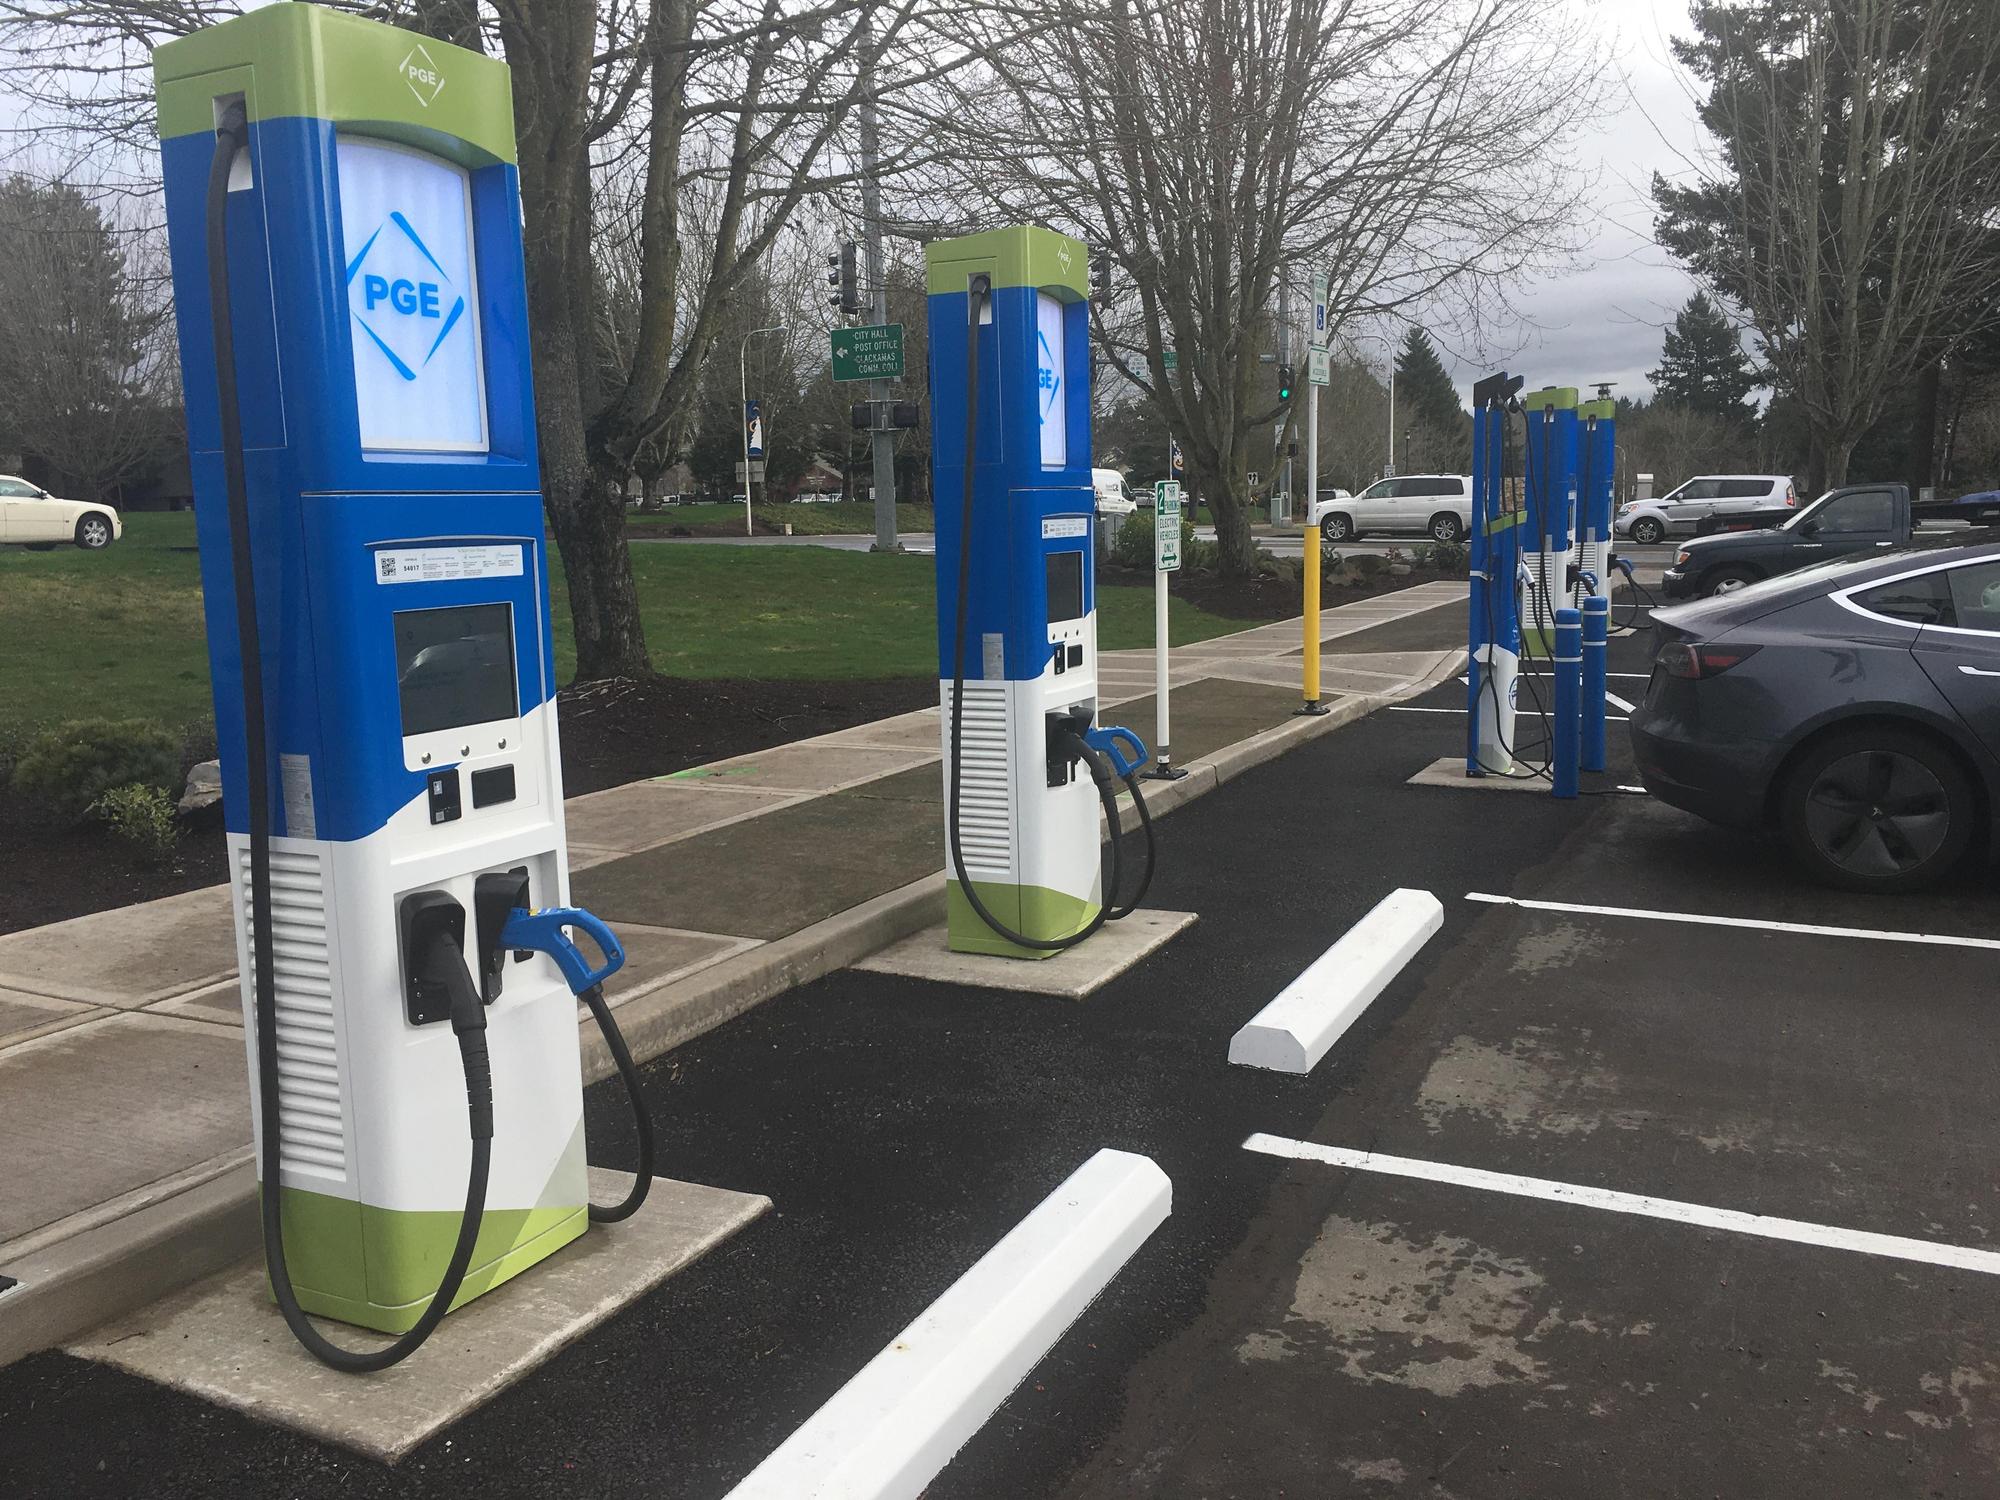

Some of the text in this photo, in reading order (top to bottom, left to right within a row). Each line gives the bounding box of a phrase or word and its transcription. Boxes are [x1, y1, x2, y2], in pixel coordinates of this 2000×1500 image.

[408, 65, 437, 86] PGE
[1060, 252, 1070, 263] PGE
[364, 274, 441, 319] PGE
[854, 329, 888, 340] CITY HALL
[855, 340, 898, 352] POST OFFICE
[1038, 368, 1052, 389] GE
[1158, 488, 1164, 511] 2
[1159, 517, 1178, 529] ELECTRIC
[1160, 529, 1179, 541] VEHICLES
[1164, 543, 1174, 553] ONLY
